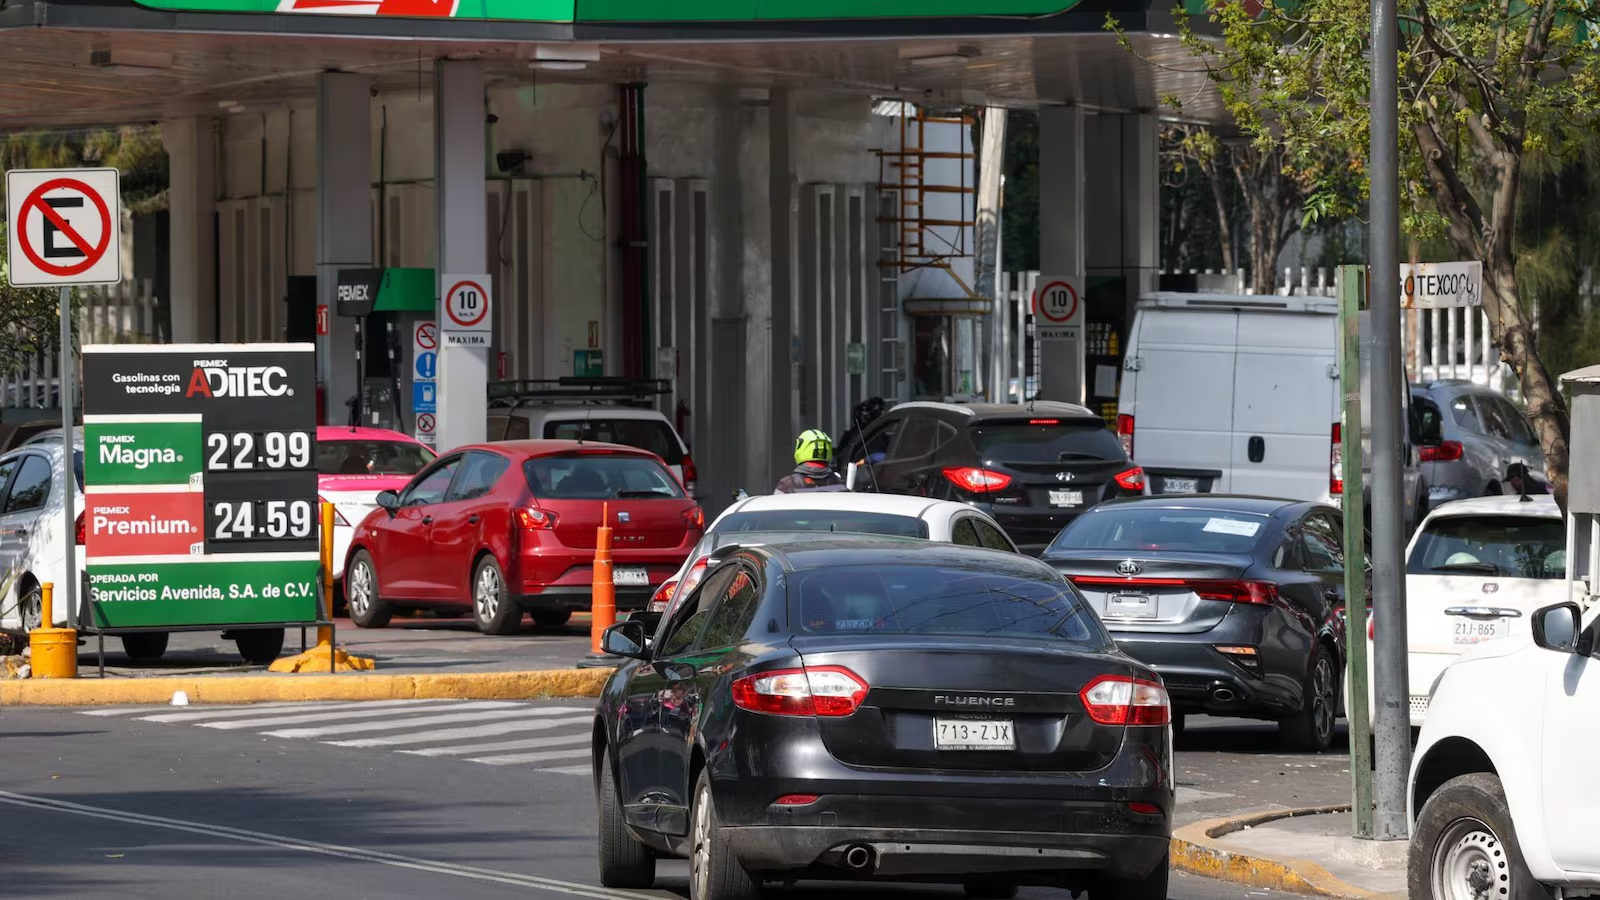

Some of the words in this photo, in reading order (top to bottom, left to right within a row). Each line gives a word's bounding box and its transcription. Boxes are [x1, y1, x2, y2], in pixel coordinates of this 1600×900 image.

[337, 285, 369, 301] PEMEX
[1051, 290, 1067, 307] 10
[459, 291, 477, 309] 10
[448, 336, 485, 344] MAXIMA
[193, 359, 228, 368] PEMEX
[112, 372, 160, 383] Gasolinas
[162, 374, 180, 382] con
[125, 383, 181, 395] tecnología
[99, 435, 135, 443] PEMEX
[99, 444, 175, 469] Magna
[207, 432, 310, 470] 22.99
[190, 475, 200, 484] 87
[93, 506, 130, 514] PEMEX
[93, 515, 190, 535] Premium
[214, 501, 311, 539] 24.59
[90, 574, 136, 584] OPERADA
[138, 573, 159, 582] POR
[91, 586, 157, 602] Servicios
[160, 585, 225, 600] Avenida,
[228, 584, 258, 599] S.A.
[262, 584, 280, 598] de
[284, 582, 314, 597] C.V.
[1455, 623, 1496, 636] 21J-865
[934, 695, 1015, 706] FLUENCE
[940, 724, 1009, 741] 713-ZJX
